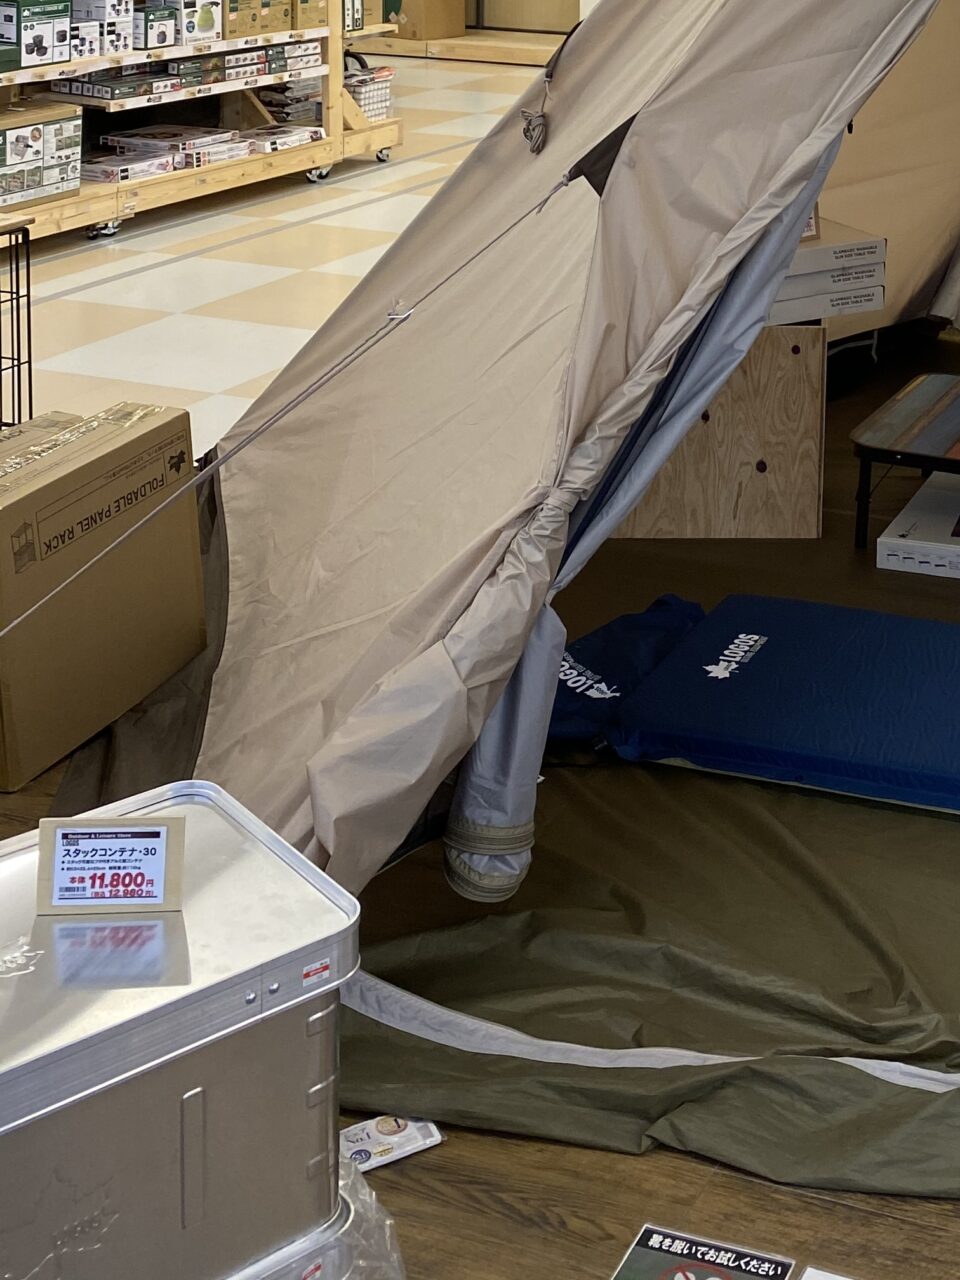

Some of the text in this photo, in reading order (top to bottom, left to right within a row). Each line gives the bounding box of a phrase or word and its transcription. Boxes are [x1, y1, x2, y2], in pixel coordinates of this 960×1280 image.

[44, 474, 165, 555] FOLDABLE PANEL RACK
[719, 633, 761, 662] LOGOS
[69, 876, 86, 884] 本体
[648, 1233, 783, 1277] 靴を脱いでお試しください
